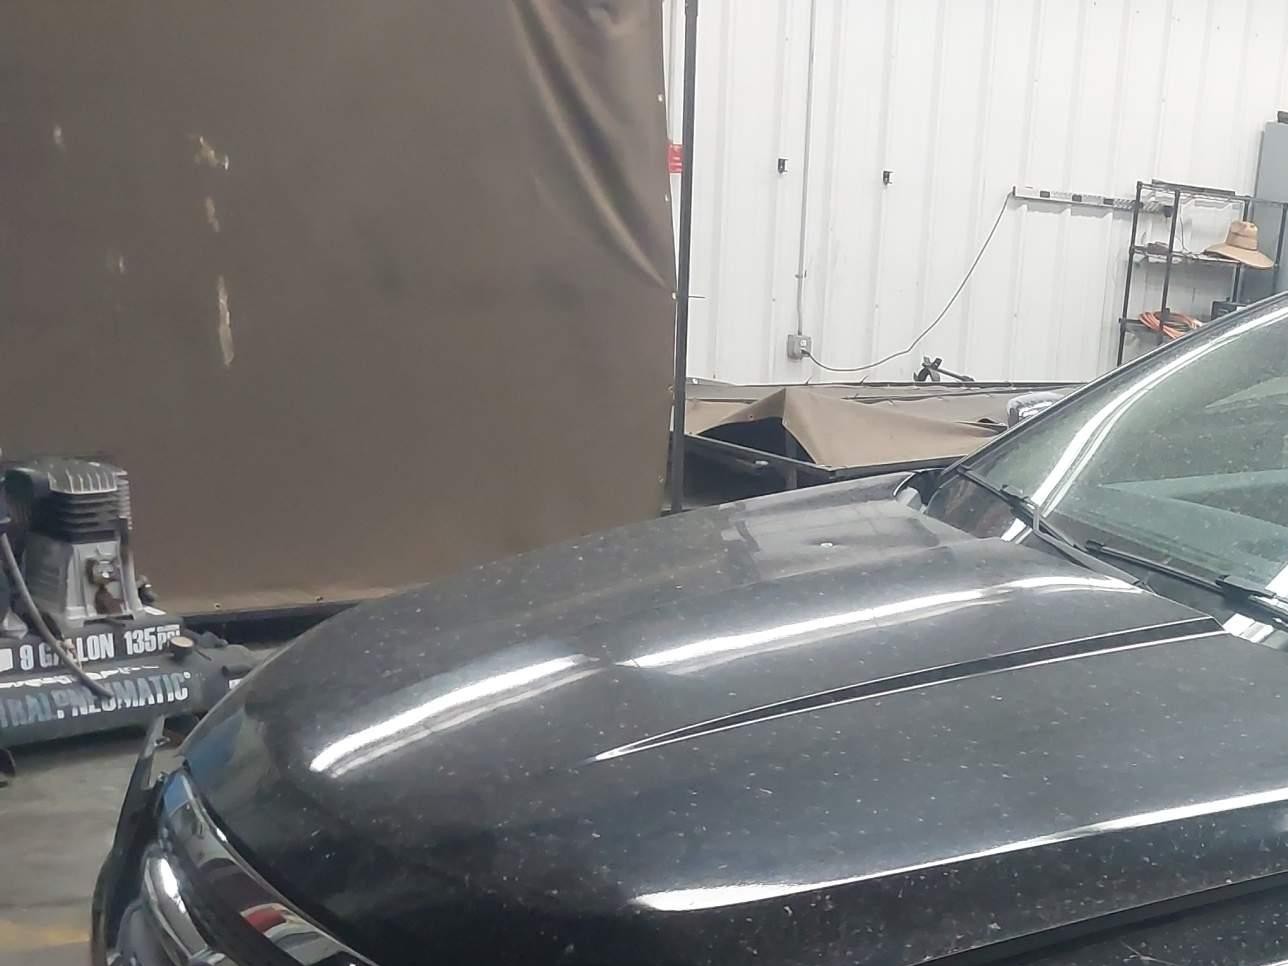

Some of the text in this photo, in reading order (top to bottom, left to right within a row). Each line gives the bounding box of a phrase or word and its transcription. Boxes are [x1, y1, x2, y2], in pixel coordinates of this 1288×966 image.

[19, 644, 35, 671] 8
[39, 631, 115, 669] GLON
[124, 627, 157, 656] 135
